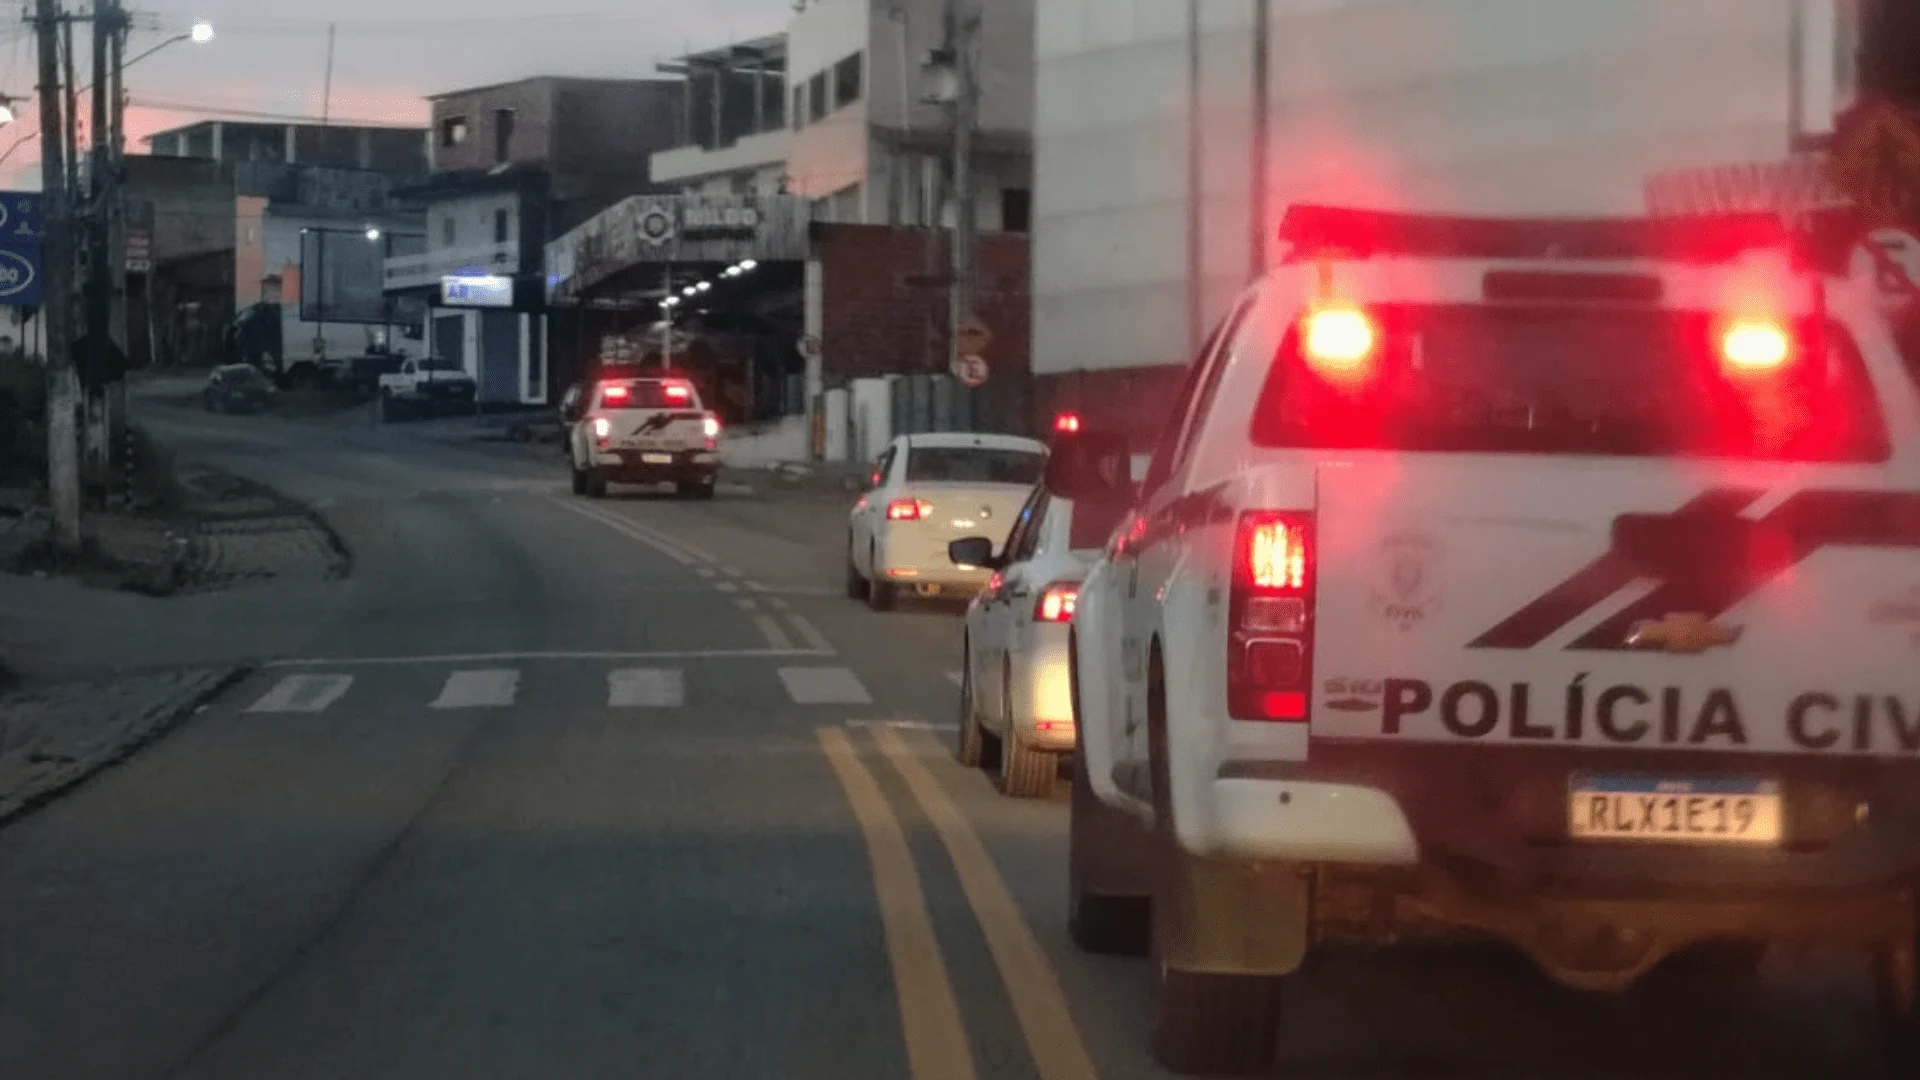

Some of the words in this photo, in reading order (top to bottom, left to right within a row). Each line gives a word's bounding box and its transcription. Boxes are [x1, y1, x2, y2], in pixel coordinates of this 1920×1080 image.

[1381, 671, 1748, 745] POLÍCIA
[1786, 691, 1920, 750] CIV
[1590, 795, 1757, 834] RLX1E19
